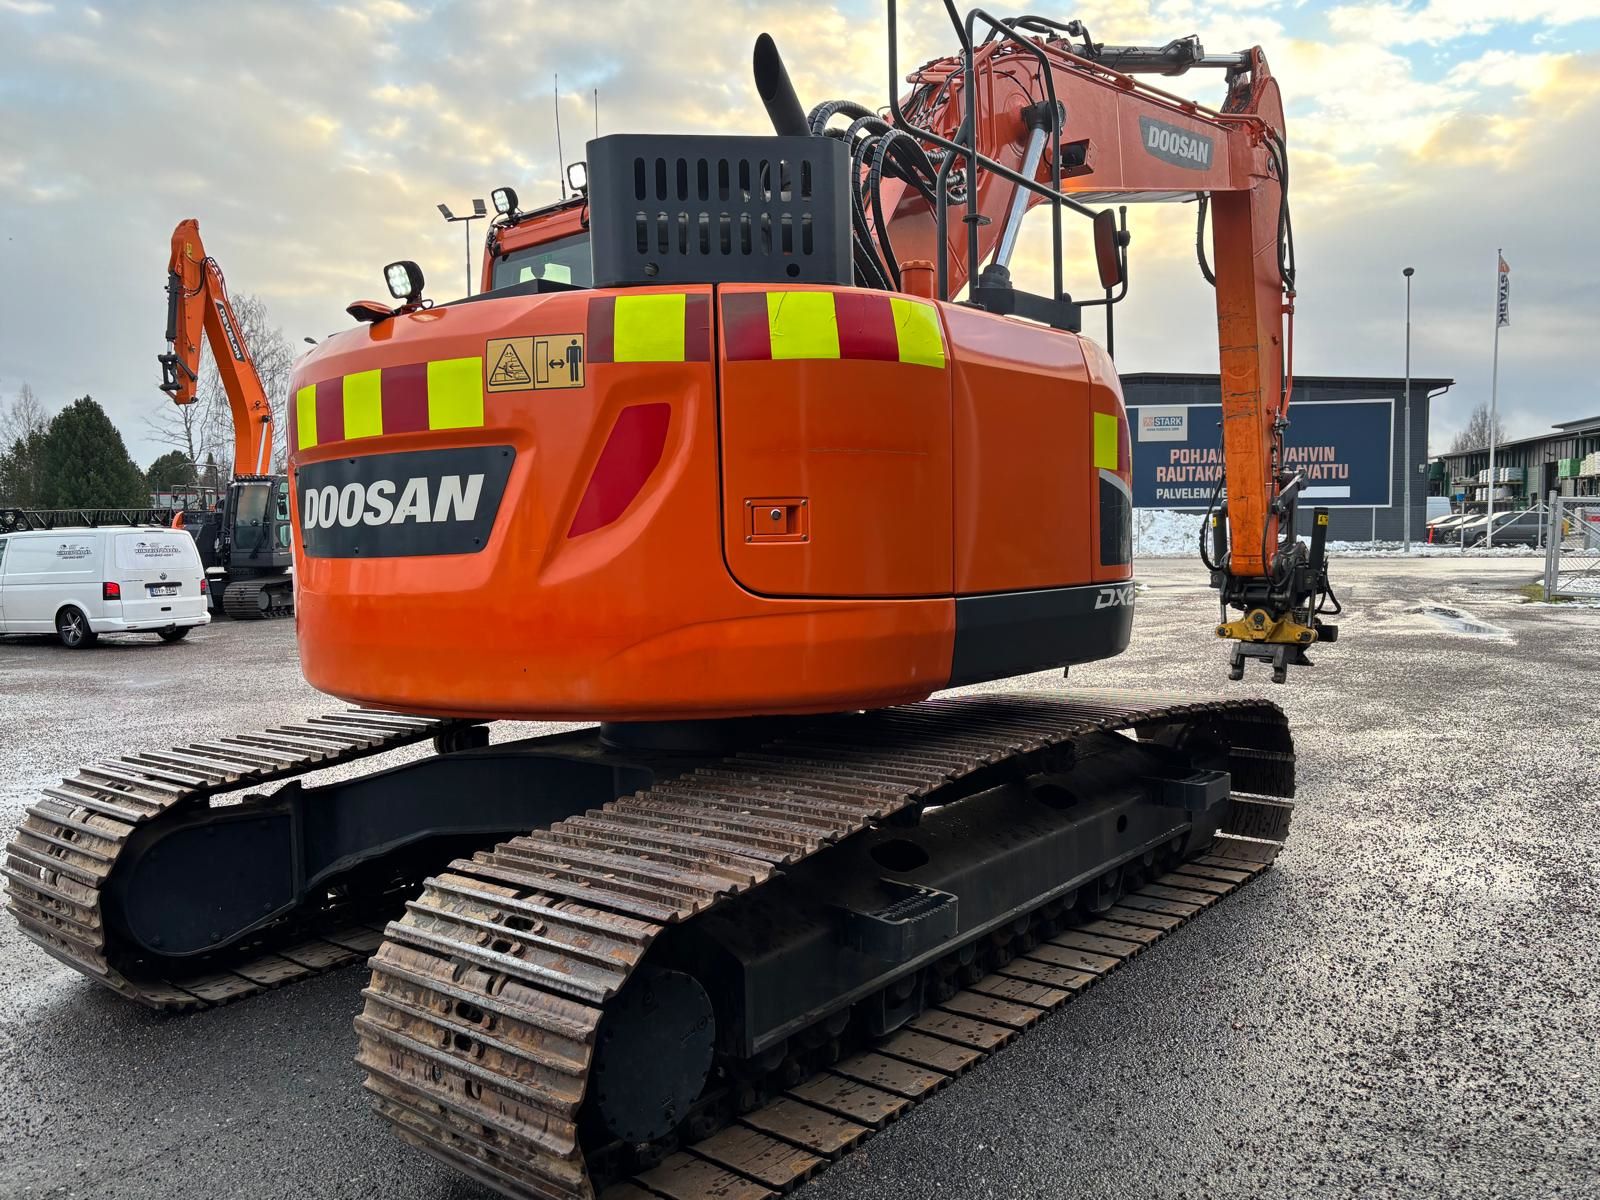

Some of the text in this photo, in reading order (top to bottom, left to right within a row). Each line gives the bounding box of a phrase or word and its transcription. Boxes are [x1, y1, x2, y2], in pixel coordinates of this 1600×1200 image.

[1148, 126, 1209, 163] DOOSAN
[1499, 274, 1508, 324] STARK
[219, 308, 241, 359] DEVELON
[1154, 417, 1182, 426] STARK
[1156, 466, 1226, 482] RAUTAKA
[303, 473, 485, 530] DOOSAN
